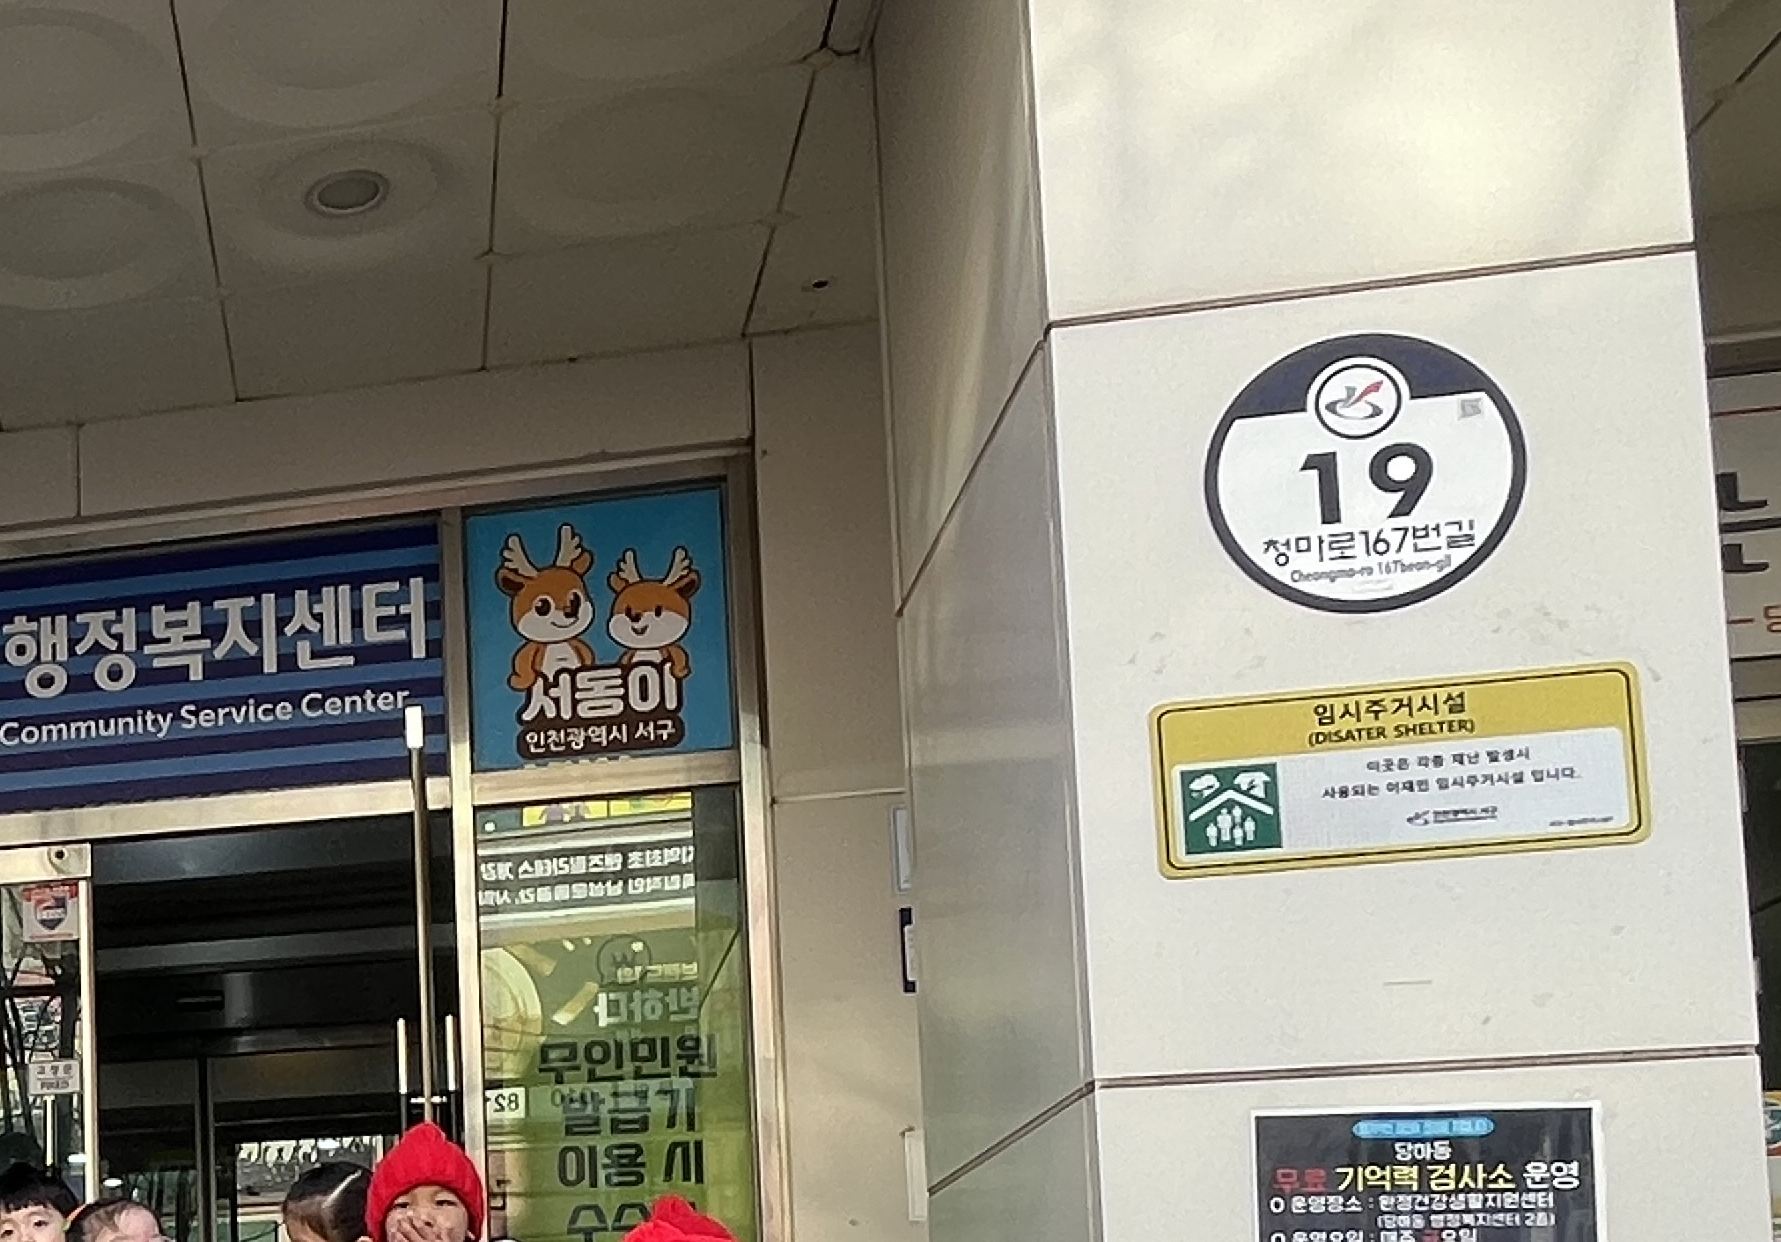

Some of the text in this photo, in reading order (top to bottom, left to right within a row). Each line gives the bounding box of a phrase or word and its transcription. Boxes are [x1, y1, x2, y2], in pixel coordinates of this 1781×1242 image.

[1299, 442, 1434, 525] 19
[1262, 519, 1476, 567] 청마로167번길
[1290, 553, 1452, 584] Cheongma-ro 167beon-gil
[2, 576, 426, 699] 행정복지센터
[180, 697, 294, 730] Service
[301, 687, 410, 718] Center
[521, 662, 678, 721] 서동이
[1313, 691, 1468, 727] 임시주거시설
[525, 719, 676, 753] 인천광역시 서구
[1308, 718, 1476, 748] (DISATER SHELTER)
[1366, 757, 1411, 773] 이곳은
[1322, 783, 1380, 799] 사용되는
[1436, 770, 1524, 791] 임시주거시설
[539, 1034, 718, 1084] 무인민원
[558, 1139, 705, 1188] 이용 시
[1394, 1140, 1452, 1161] 당하동
[1334, 1164, 1419, 1193] 기억력
[1426, 1163, 1517, 1191] 검사소
[1523, 1160, 1580, 1189] 운영
